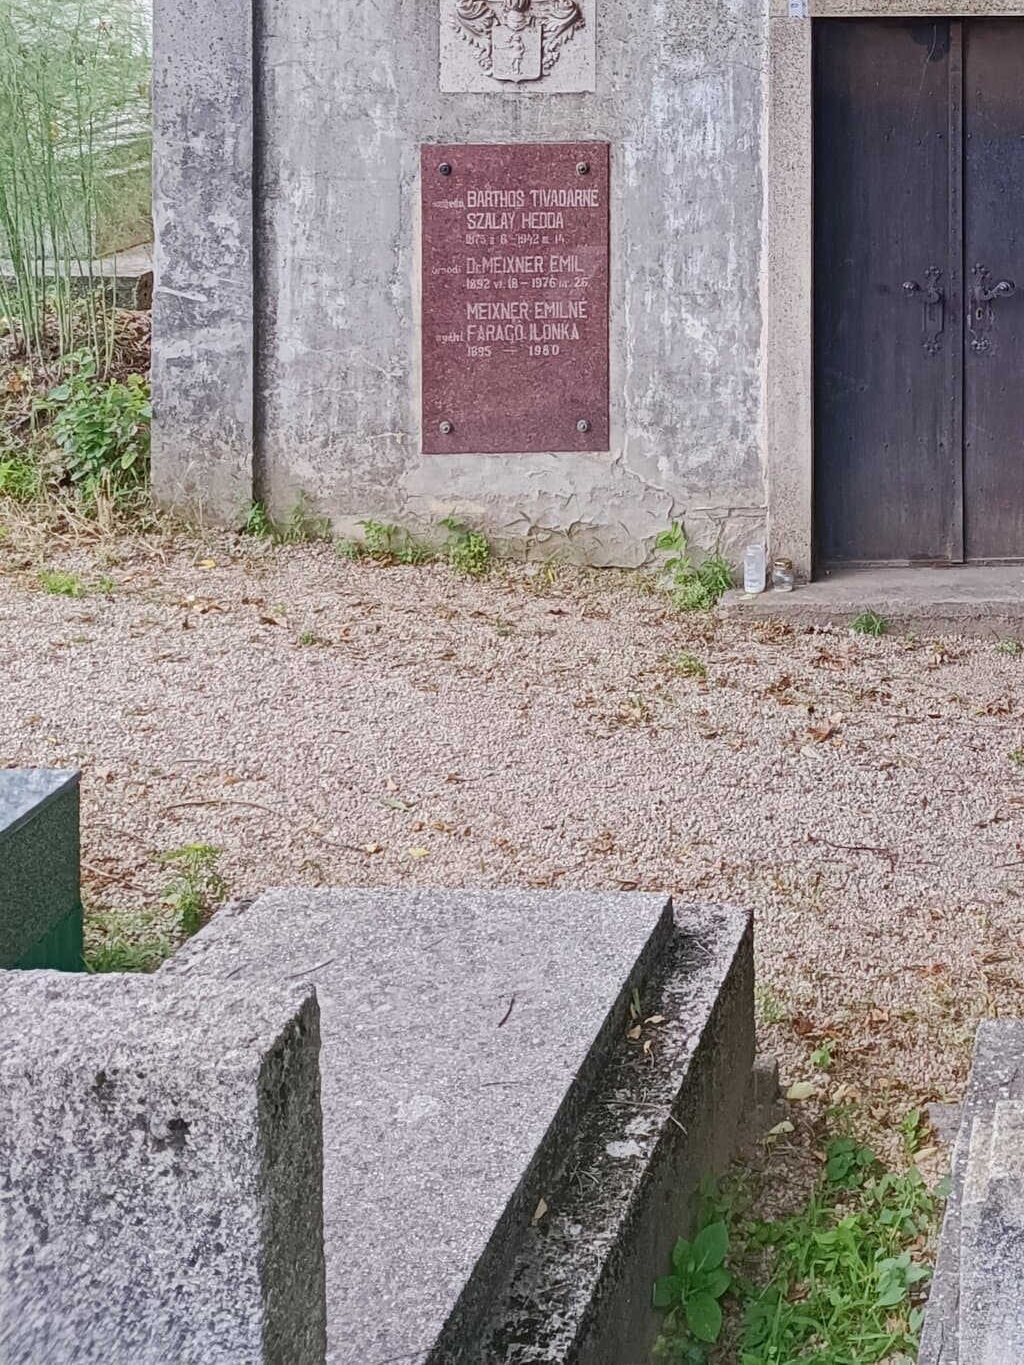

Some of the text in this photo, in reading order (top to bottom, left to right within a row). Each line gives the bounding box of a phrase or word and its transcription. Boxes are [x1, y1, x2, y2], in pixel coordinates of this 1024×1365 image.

[467, 191, 524, 208] BARTHOS
[467, 213, 563, 229] SZALAY HEDDA
[550, 256, 584, 272] EMIL
[466, 279, 490, 289] 1892
[532, 277, 556, 288] 1976
[467, 303, 529, 320] MEIXNER
[529, 322, 579, 341] ILONKA
[467, 347, 491, 357] 1895
[529, 345, 559, 355] 1980
